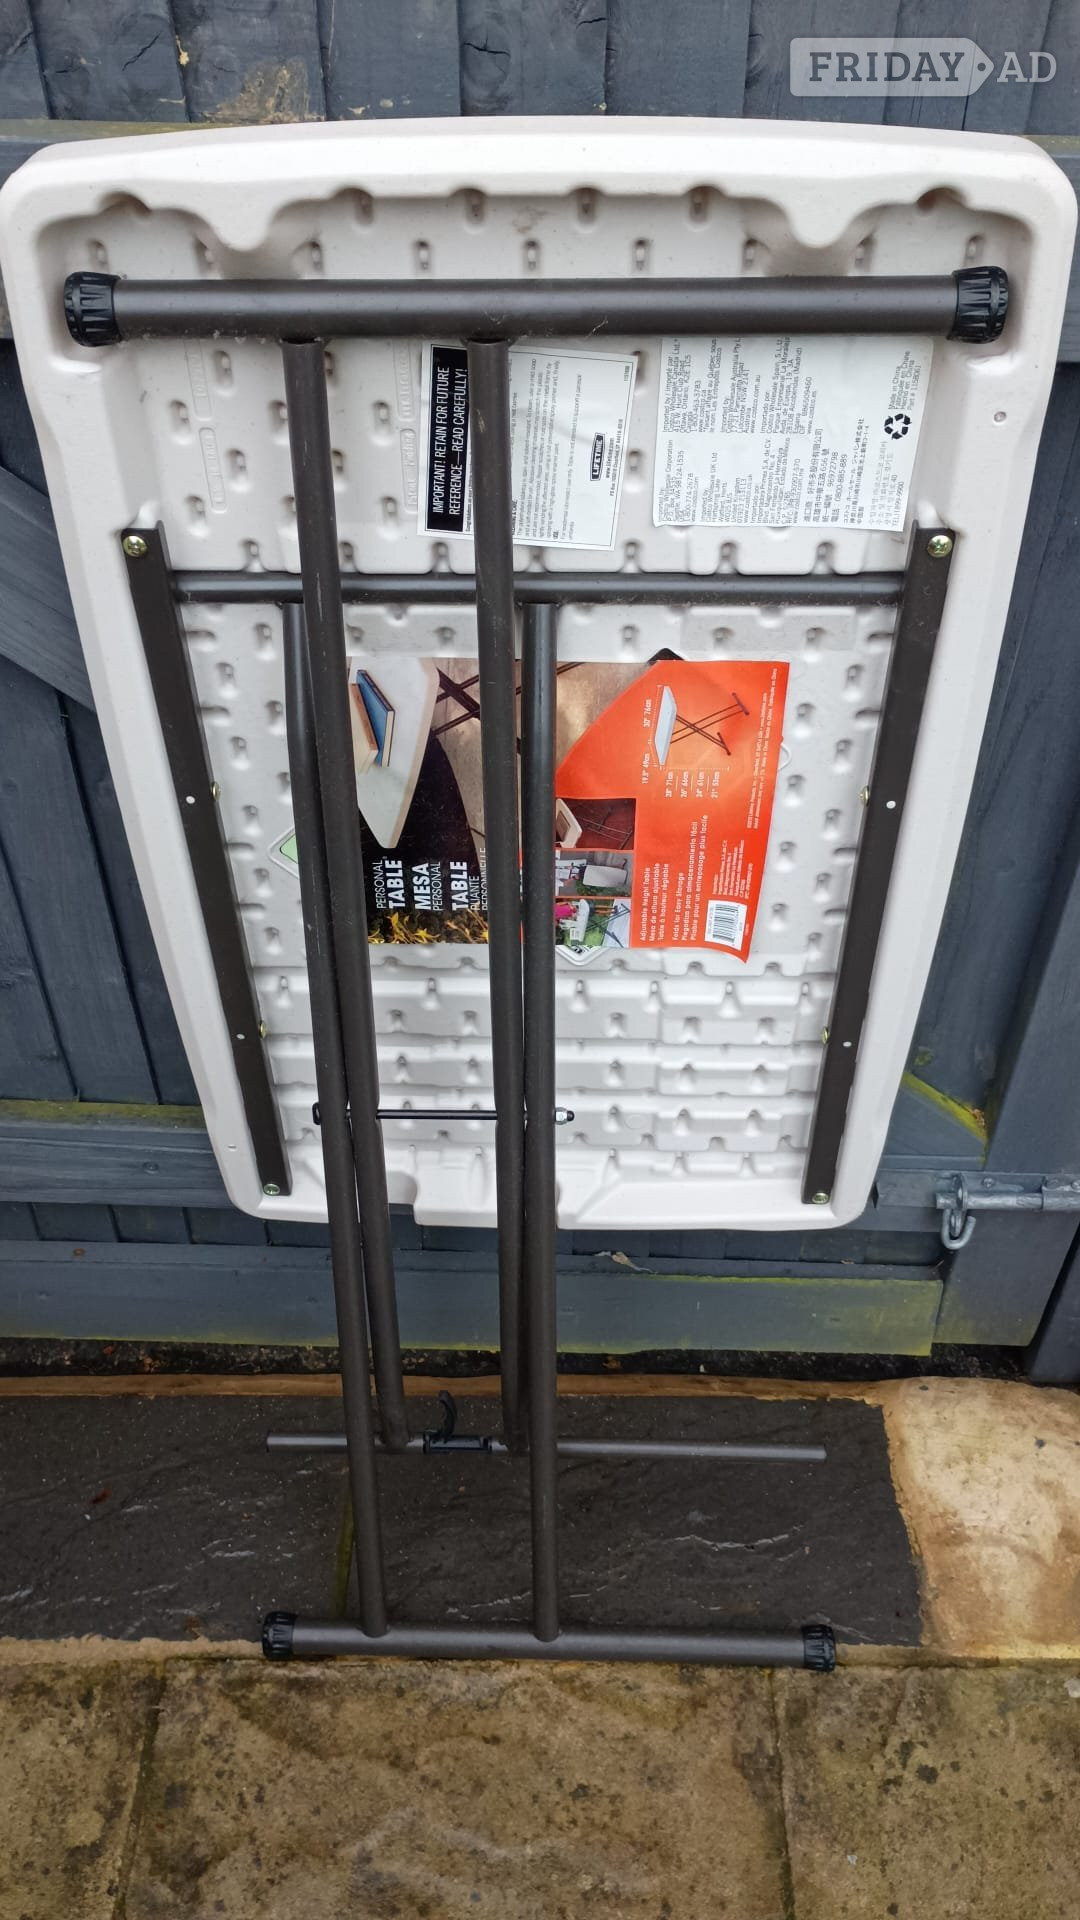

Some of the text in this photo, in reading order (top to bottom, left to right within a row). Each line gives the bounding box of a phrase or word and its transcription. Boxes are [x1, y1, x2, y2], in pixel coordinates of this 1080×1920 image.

[892, 366, 902, 384] China
[453, 369, 467, 424] CAREFULLY!
[691, 381, 700, 432] 1-800-463-3783
[750, 375, 759, 433] www.costco.com.au
[769, 382, 777, 412] Wholesale
[789, 376, 798, 411] Alcobendas
[888, 394, 897, 409] Made
[901, 392, 910, 409] Hecho
[760, 403, 768, 433] Importado
[807, 391, 817, 433] www.costco.es
[432, 367, 449, 513] IMPORTANT! RETAIN FOR FUTURE
[592, 439, 602, 475] LIFETIME
[826, 452, 838, 487] 96972798
[834, 454, 847, 501] 0800-885-889
[699, 815, 708, 833] facile
[698, 836, 706, 848] plus
[373, 860, 387, 908] PERSONAL
[412, 863, 431, 909] MESA
[430, 862, 443, 911] PERSONAL
[450, 861, 469, 910] TABLE
[469, 876, 480, 910] PLIANTE
[675, 872, 685, 896] Storage
[674, 899, 682, 912] Easy
